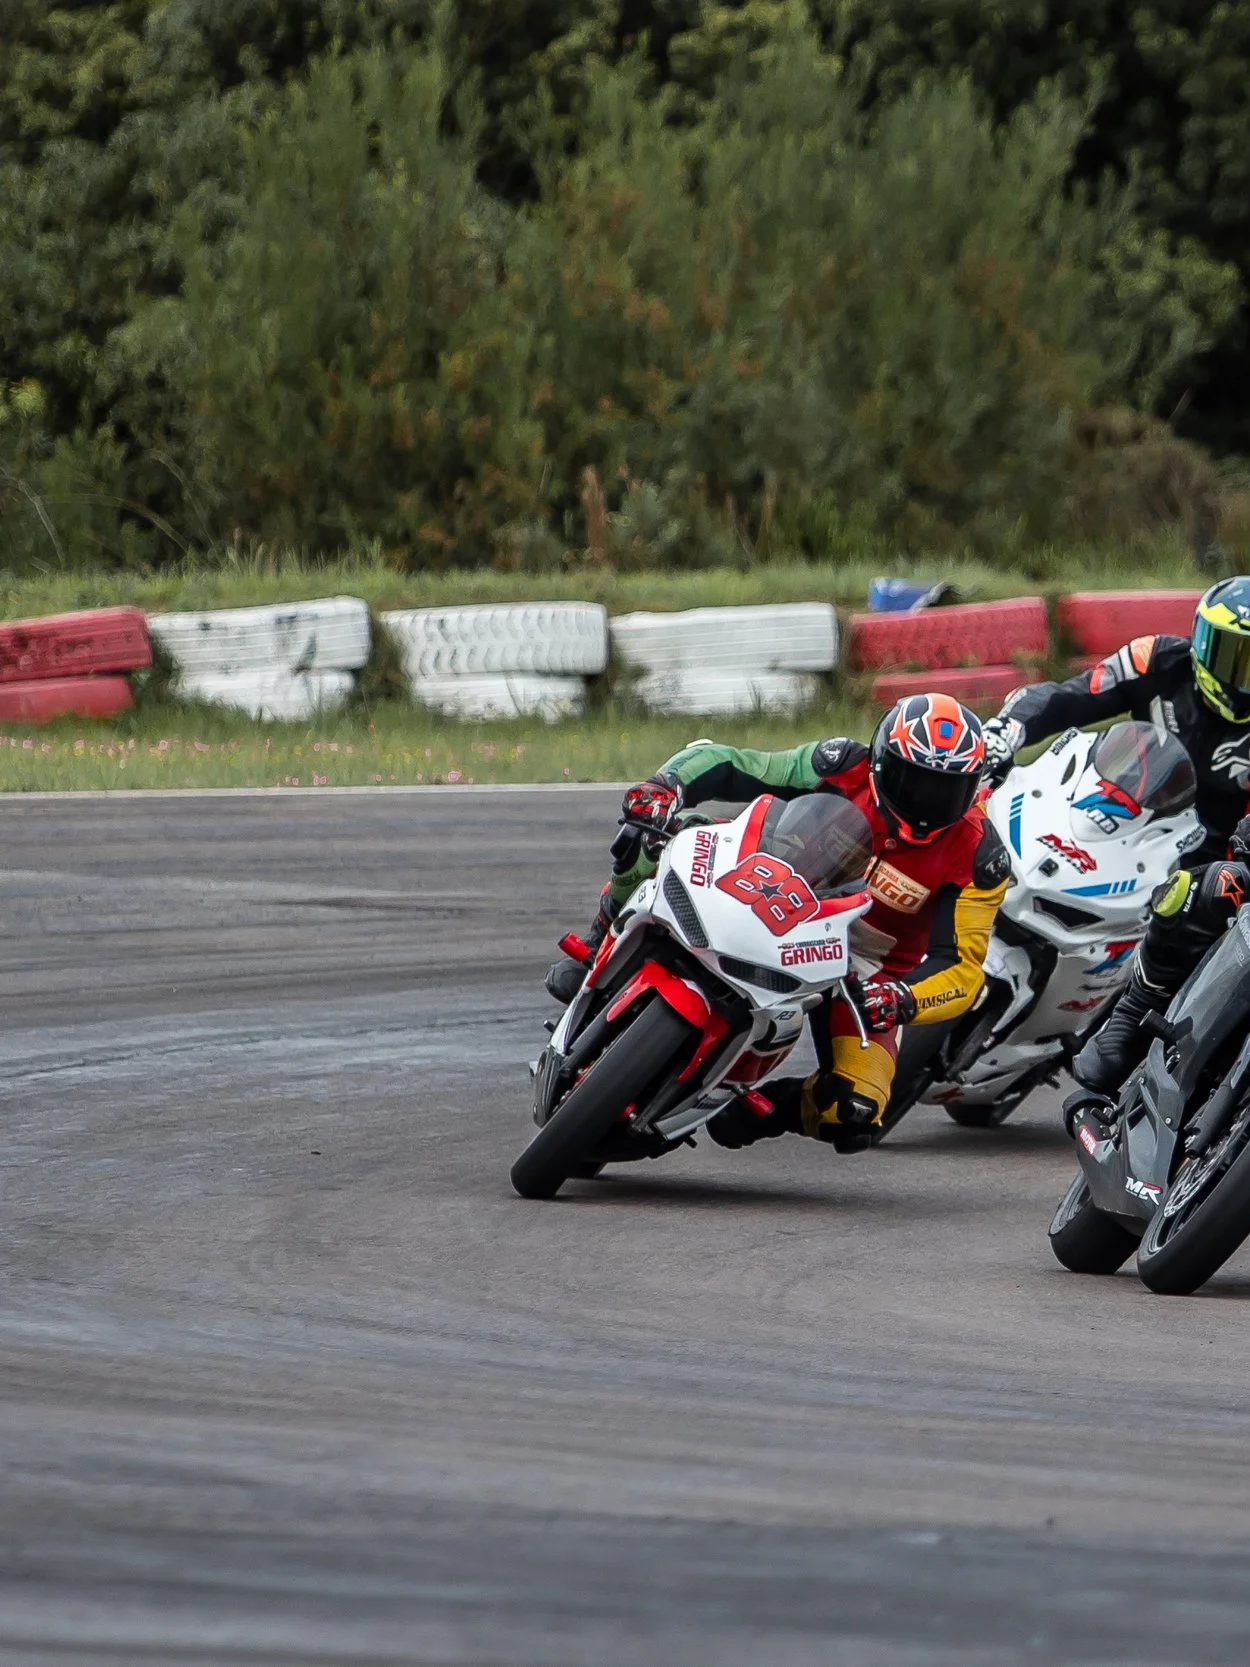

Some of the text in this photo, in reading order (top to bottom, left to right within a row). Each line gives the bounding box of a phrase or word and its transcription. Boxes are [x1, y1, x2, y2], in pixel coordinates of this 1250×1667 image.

[690, 831, 711, 887] GRINGO
[715, 852, 820, 937] 88
[781, 945, 843, 966] GRINGO
[774, 1010, 797, 1020] R3
